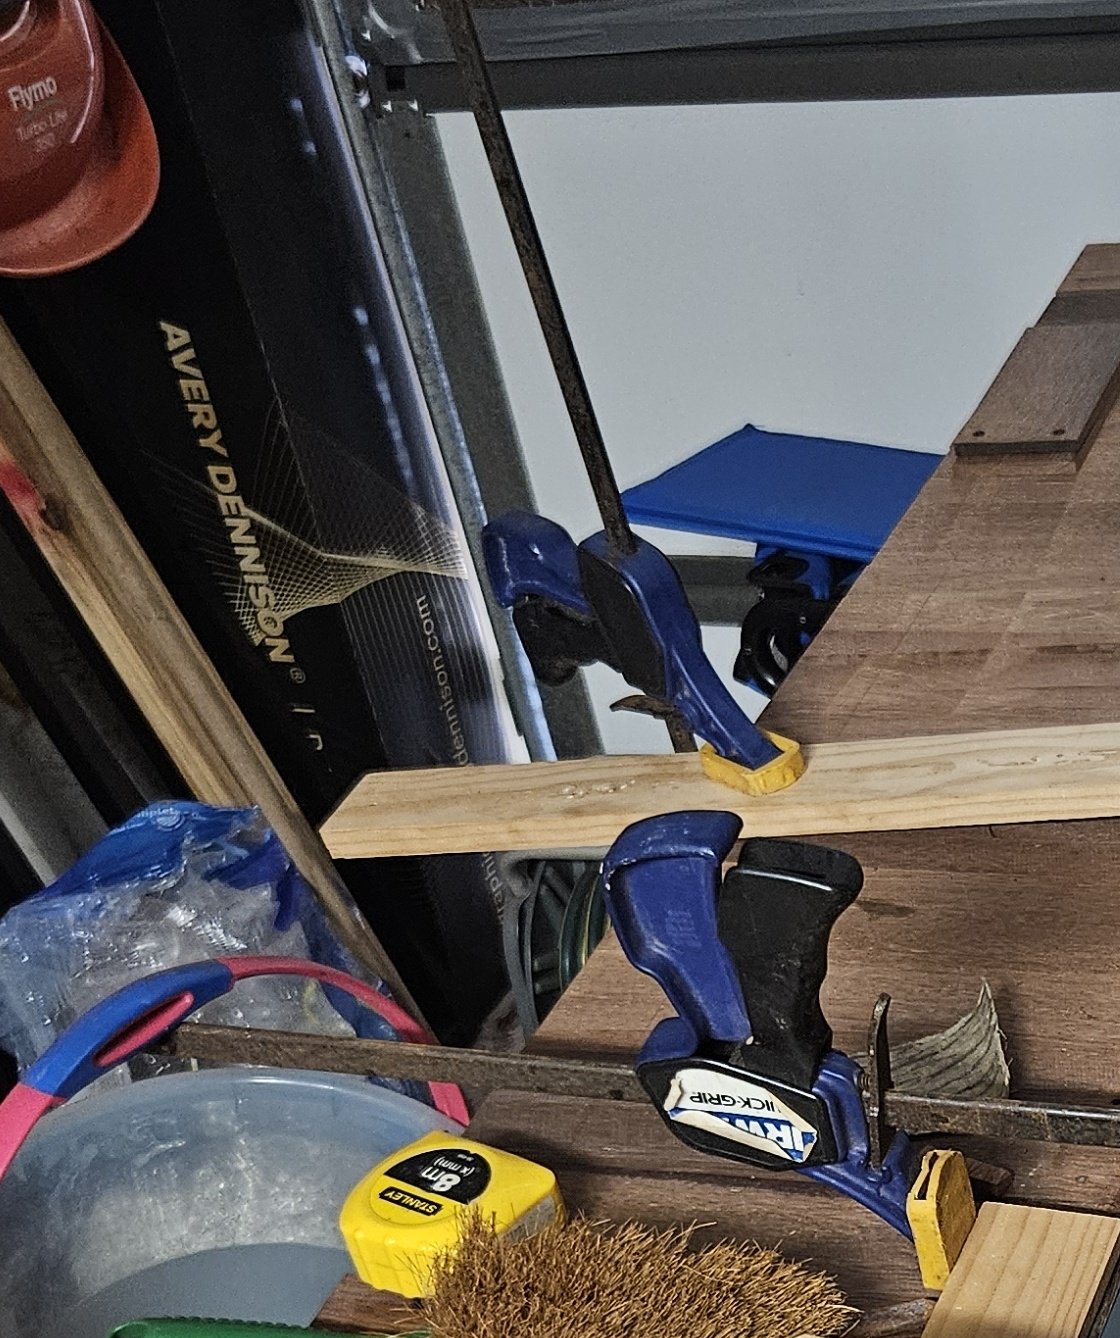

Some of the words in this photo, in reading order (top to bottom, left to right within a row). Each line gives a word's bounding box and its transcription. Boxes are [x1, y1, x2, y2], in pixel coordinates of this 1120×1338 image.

[8, 76, 57, 111] Flymo
[159, 320, 229, 459] AVERY
[421, 1166, 461, 1192] 8m
[384, 1190, 438, 1213] STANLEY
